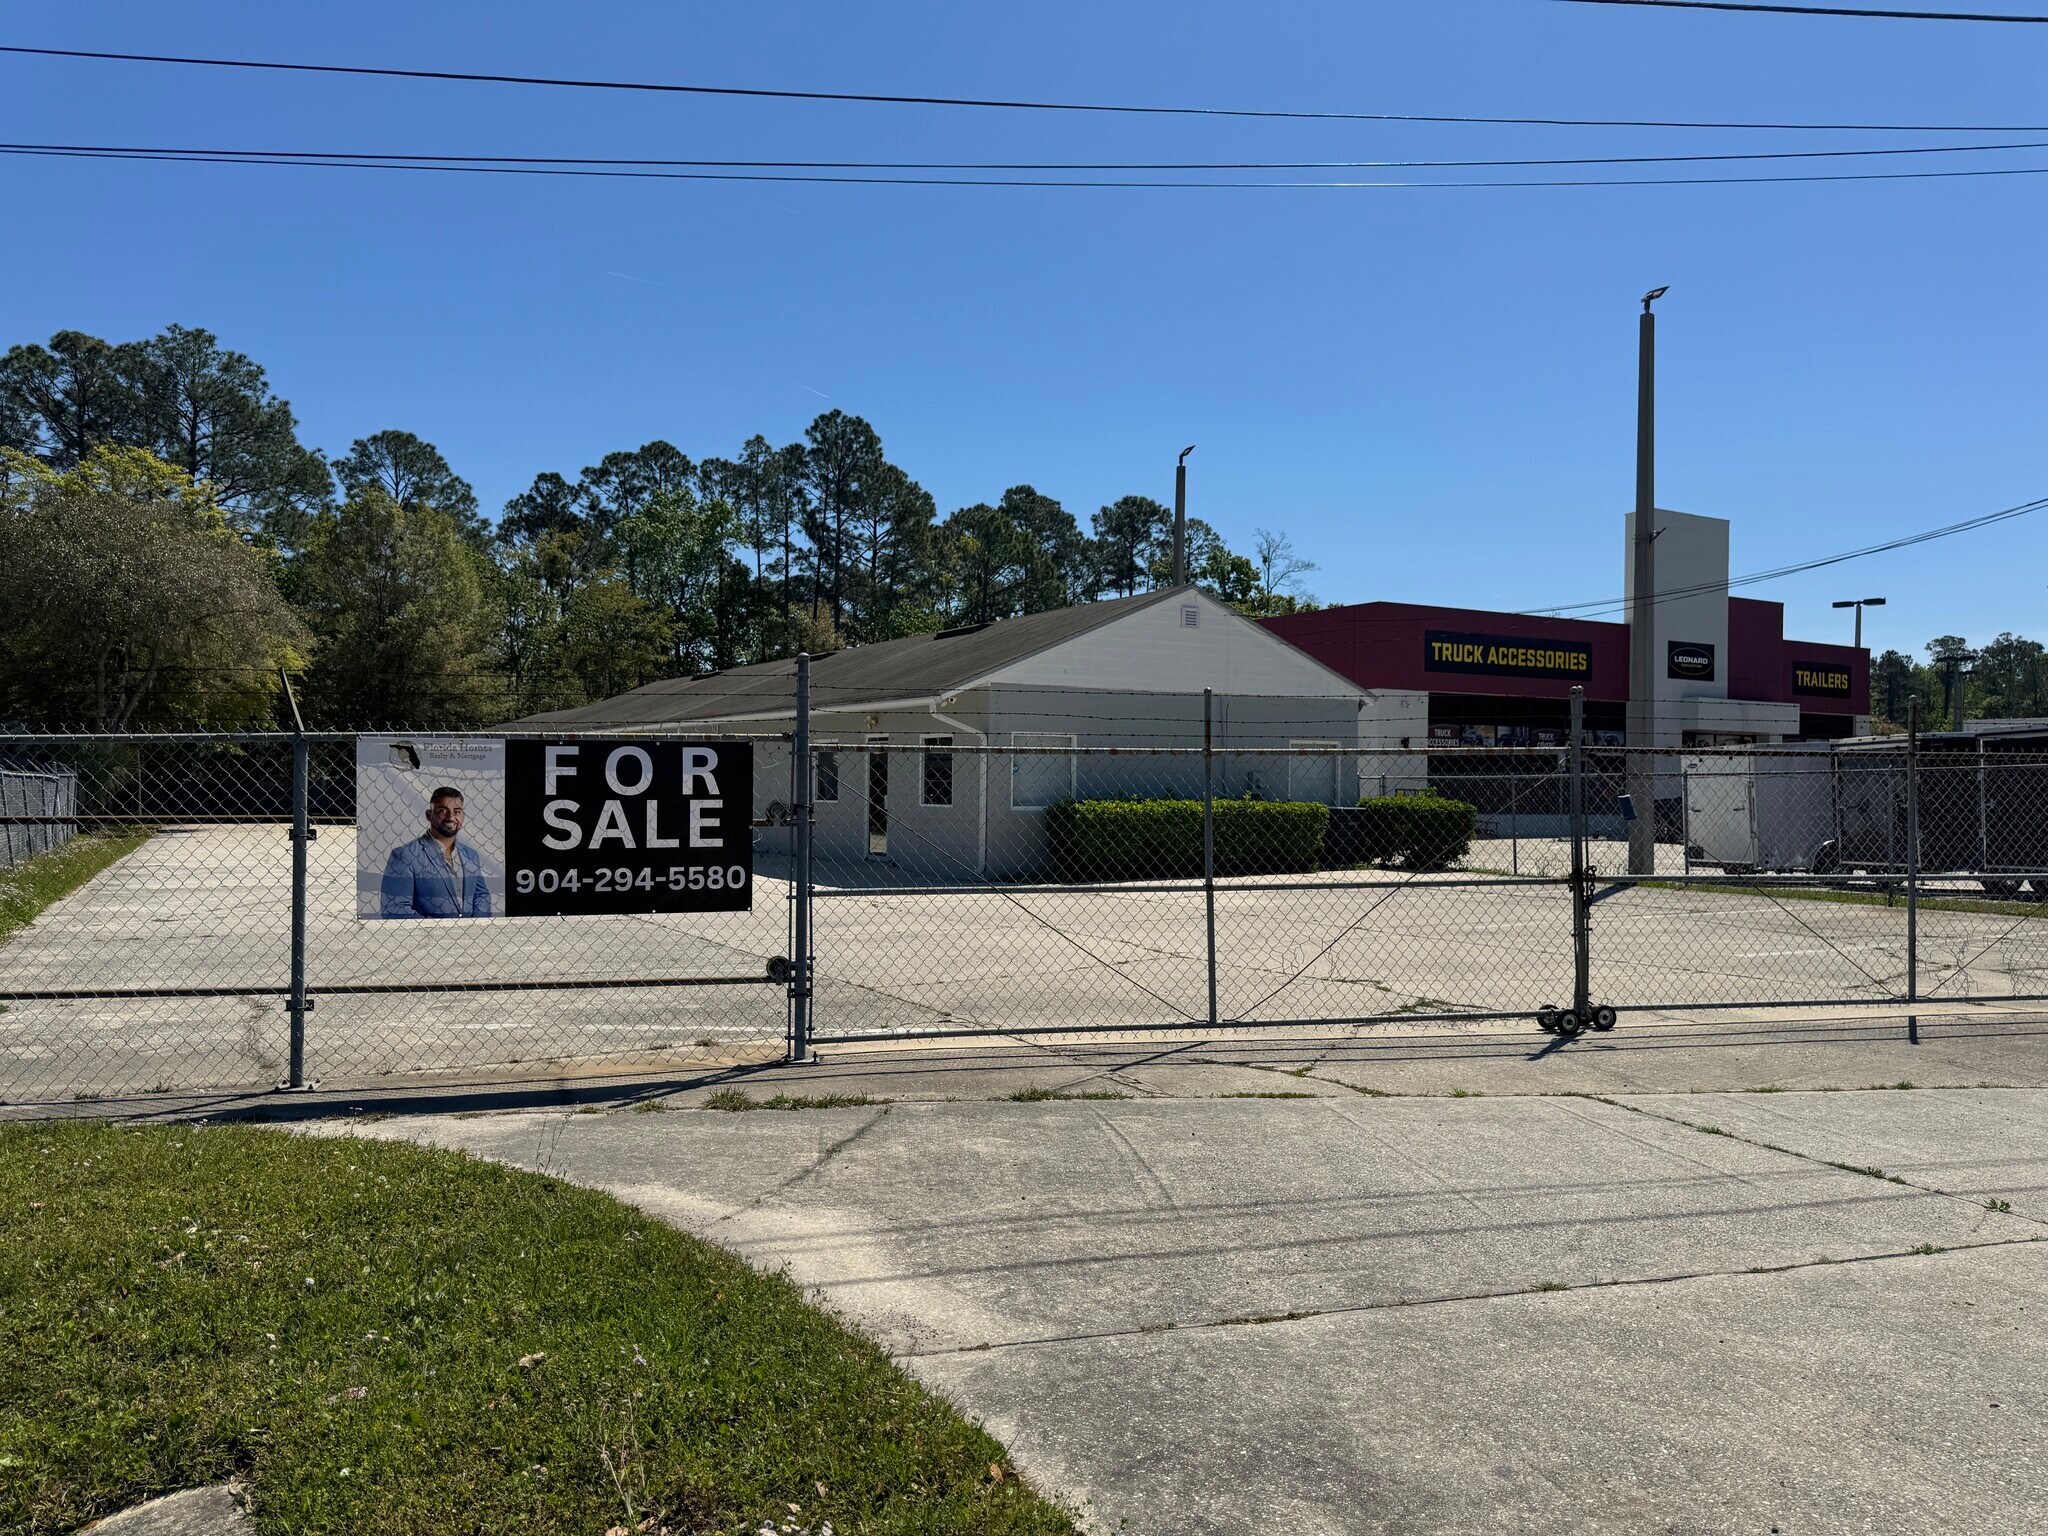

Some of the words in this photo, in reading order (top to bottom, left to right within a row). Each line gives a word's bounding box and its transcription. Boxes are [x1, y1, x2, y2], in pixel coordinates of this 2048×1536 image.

[1431, 642, 1483, 663] TRUCK
[1487, 646, 1587, 671] ACCESSORIES
[1674, 655, 1708, 664] LEONARD
[1796, 670, 1848, 689] TRAILERS
[1434, 729, 1452, 737] TRUCK
[423, 742, 457, 752] Florida
[460, 742, 493, 752] Homes
[1428, 738, 1460, 747] CCESSORIES
[429, 752, 448, 760] Realty
[458, 752, 486, 760] Mortgage
[544, 746, 720, 796] FOR
[541, 799, 724, 850] SALE
[516, 865, 746, 893] 904-294-5580
